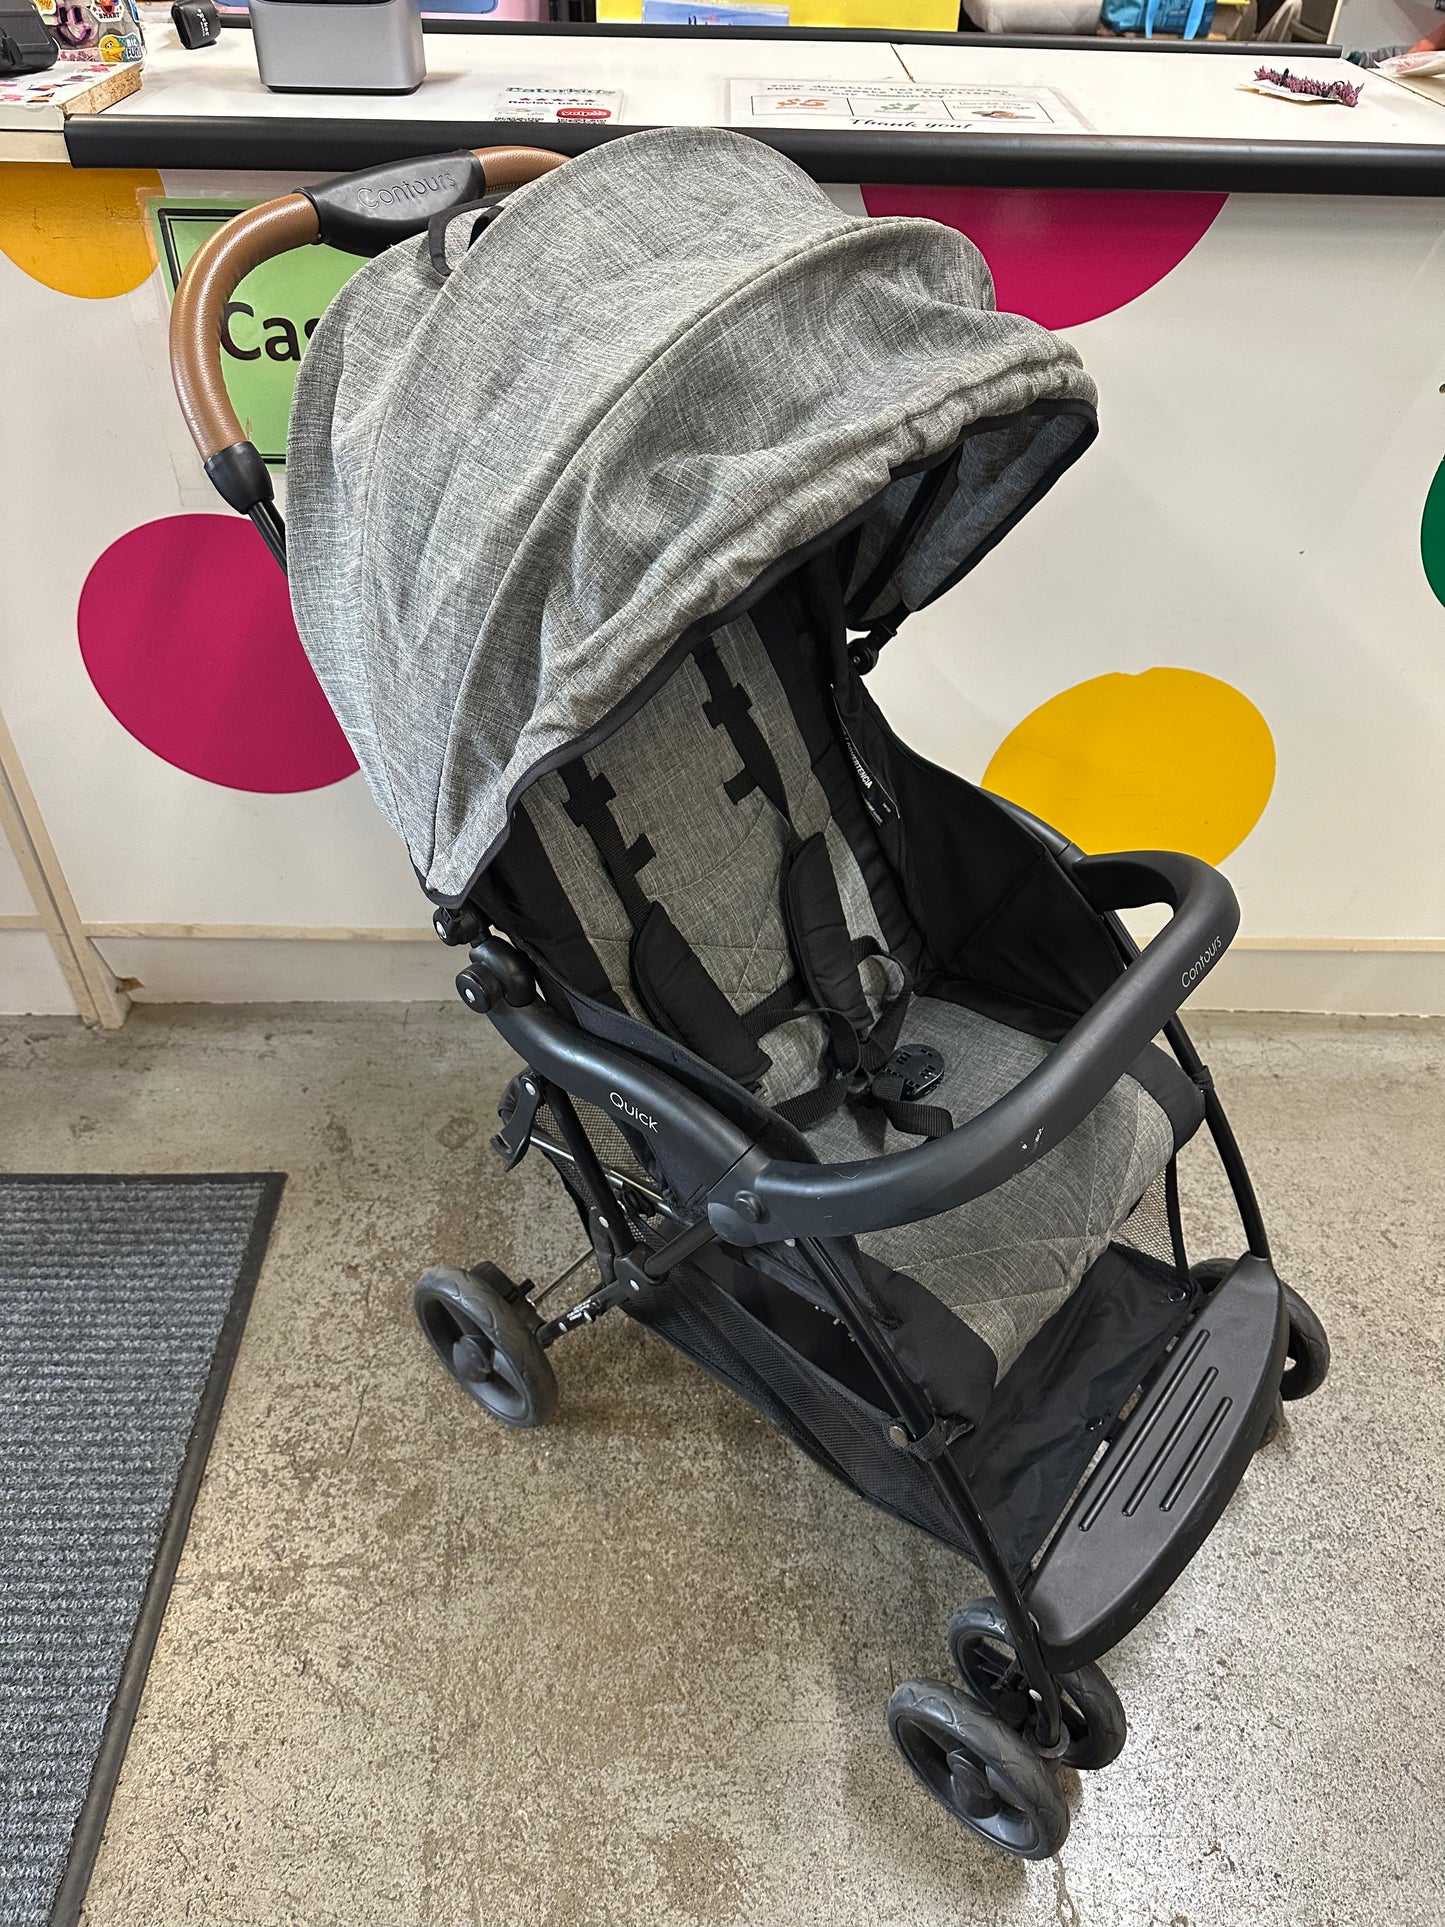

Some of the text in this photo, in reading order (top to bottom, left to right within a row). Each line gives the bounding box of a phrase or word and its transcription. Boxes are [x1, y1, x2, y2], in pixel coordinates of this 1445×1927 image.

[851, 119, 973, 129] Thank you!
[357, 173, 457, 209] Contours
[1181, 935, 1222, 988] Contours
[609, 1091, 659, 1134] Quick
